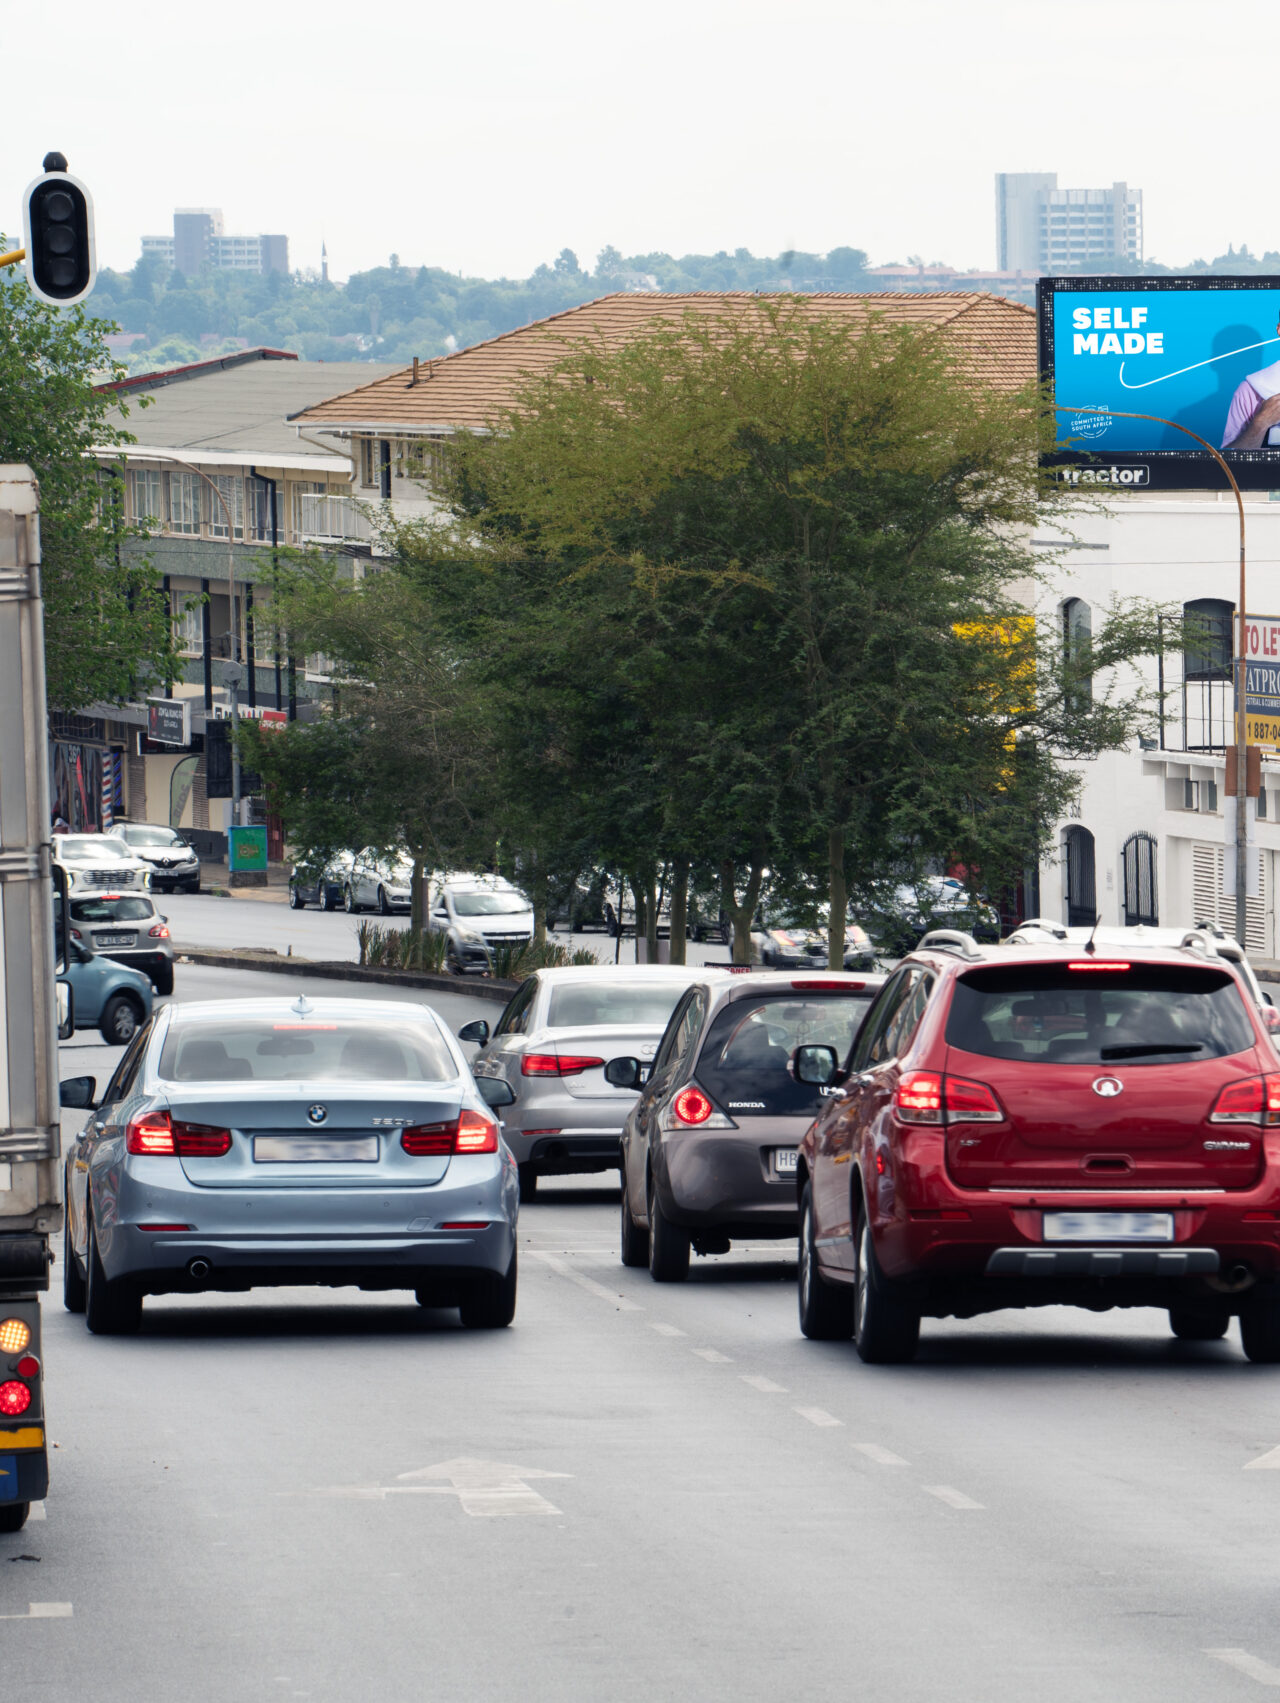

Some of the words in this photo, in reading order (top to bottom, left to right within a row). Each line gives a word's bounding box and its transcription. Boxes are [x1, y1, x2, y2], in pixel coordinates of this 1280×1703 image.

[1072, 307, 1148, 330] SELF
[1073, 332, 1164, 355] MADE
[1070, 416, 1104, 426] COMMITTED
[1071, 424, 1091, 432] SOUTH
[1092, 420, 1113, 428] AFRICA
[1062, 466, 1144, 483] tractor
